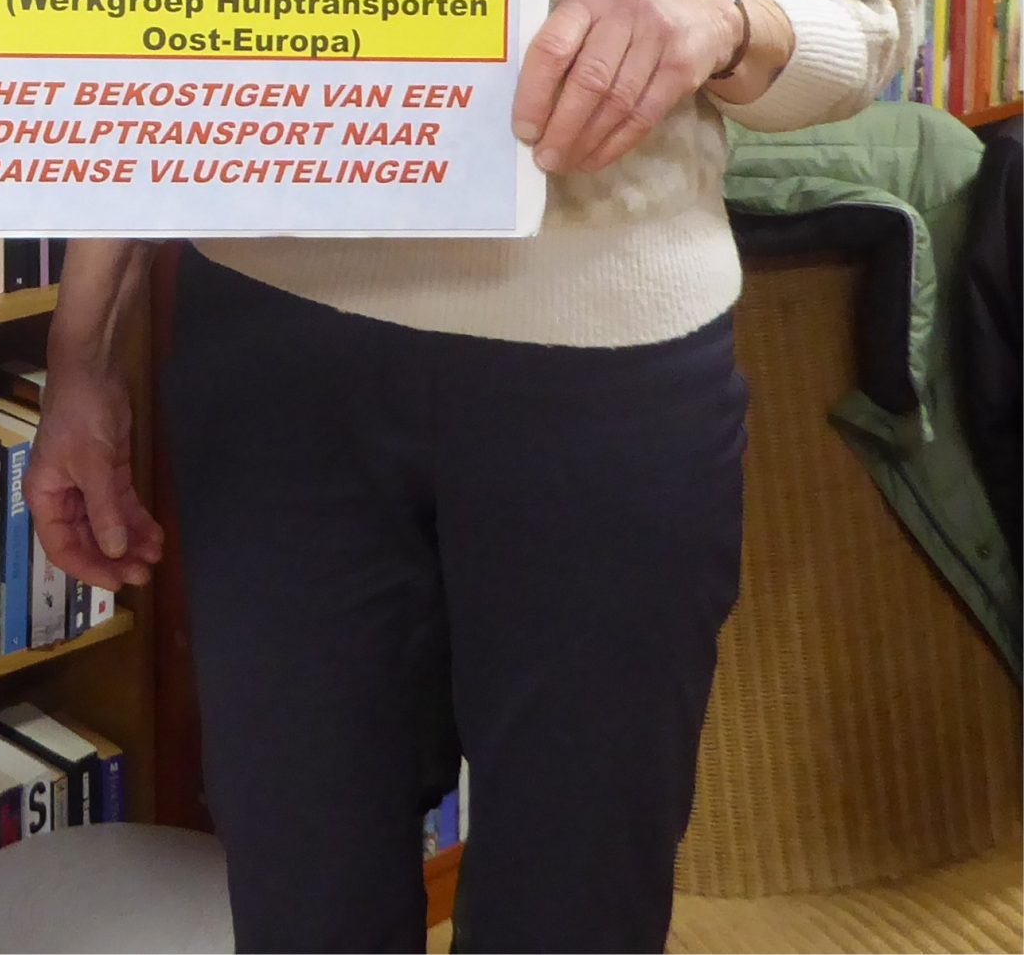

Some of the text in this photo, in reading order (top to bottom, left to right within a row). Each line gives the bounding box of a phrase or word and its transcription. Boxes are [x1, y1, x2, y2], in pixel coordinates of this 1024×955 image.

[142, 26, 362, 58] Oost-Europa)
[73, 82, 310, 108] BEKOSTIGEN
[323, 84, 393, 108] VAN
[401, 85, 474, 109] EEN
[341, 122, 441, 146] NAAR
[149, 159, 449, 185] VLUCHTELINGEN
